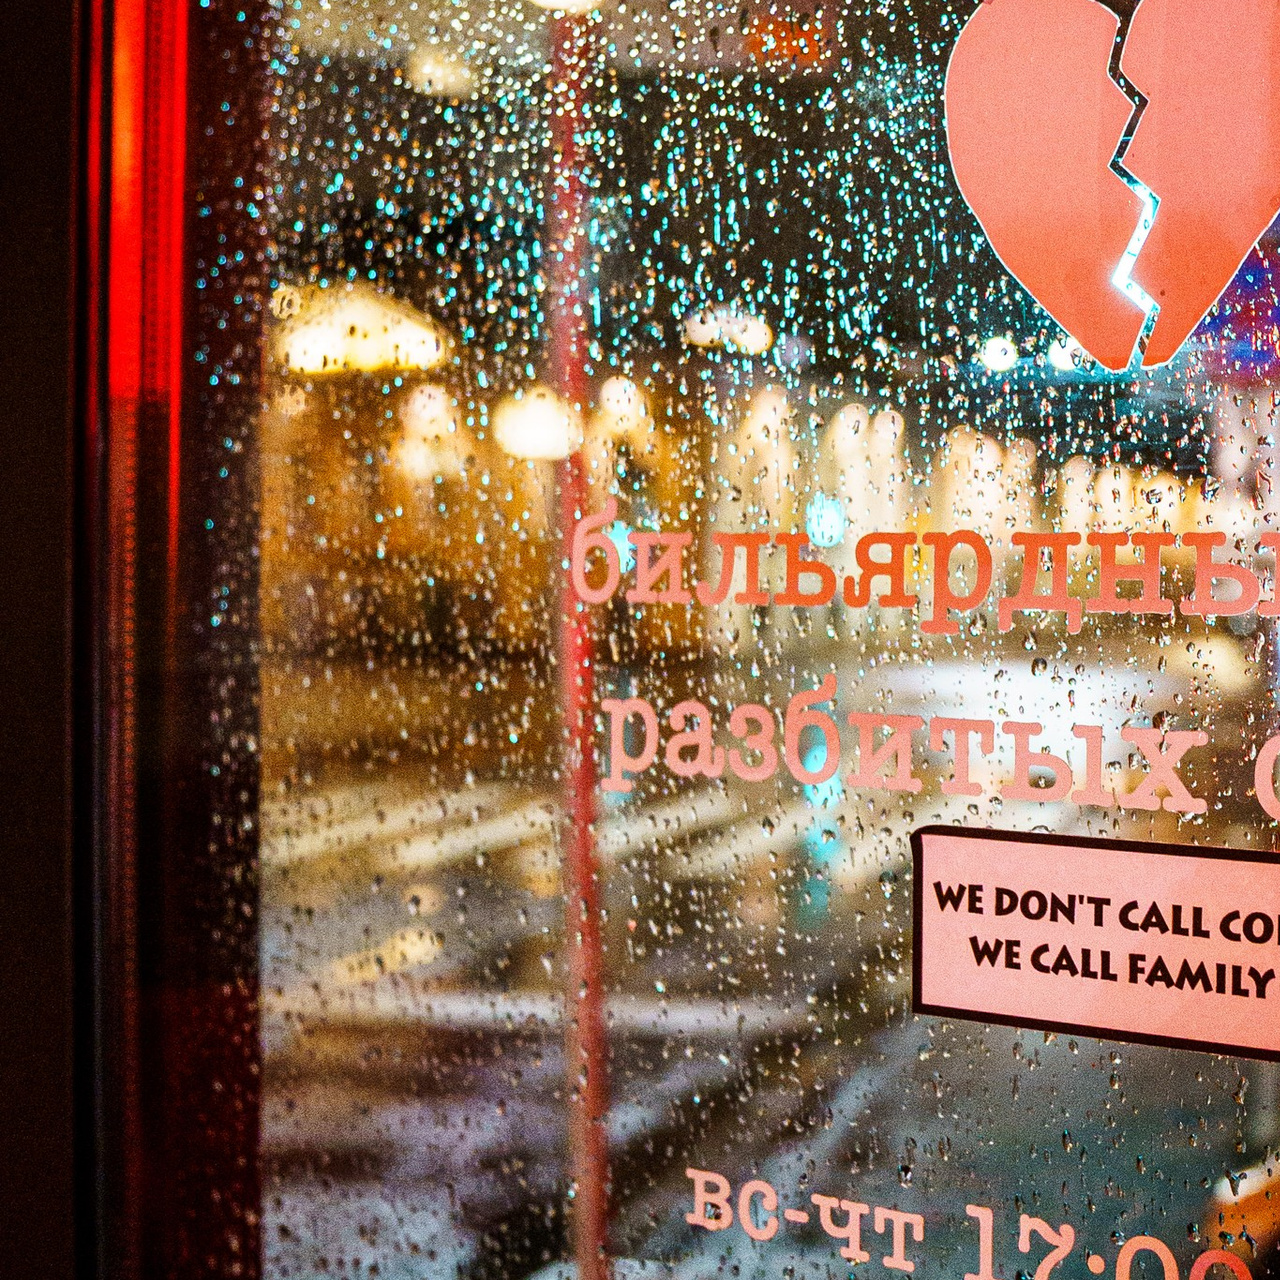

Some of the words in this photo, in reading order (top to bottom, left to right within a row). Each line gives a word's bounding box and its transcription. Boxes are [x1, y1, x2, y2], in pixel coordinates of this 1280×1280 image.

[600, 673, 1208, 813] разбитых
[933, 881, 984, 915] WE
[995, 887, 1111, 927] DON'T
[1118, 900, 1211, 939] CALL
[969, 935, 1022, 971] WE
[1030, 943, 1118, 984] CALL
[1129, 953, 1276, 1000] FAMILY
[685, 1167, 924, 1273] вс-чт
